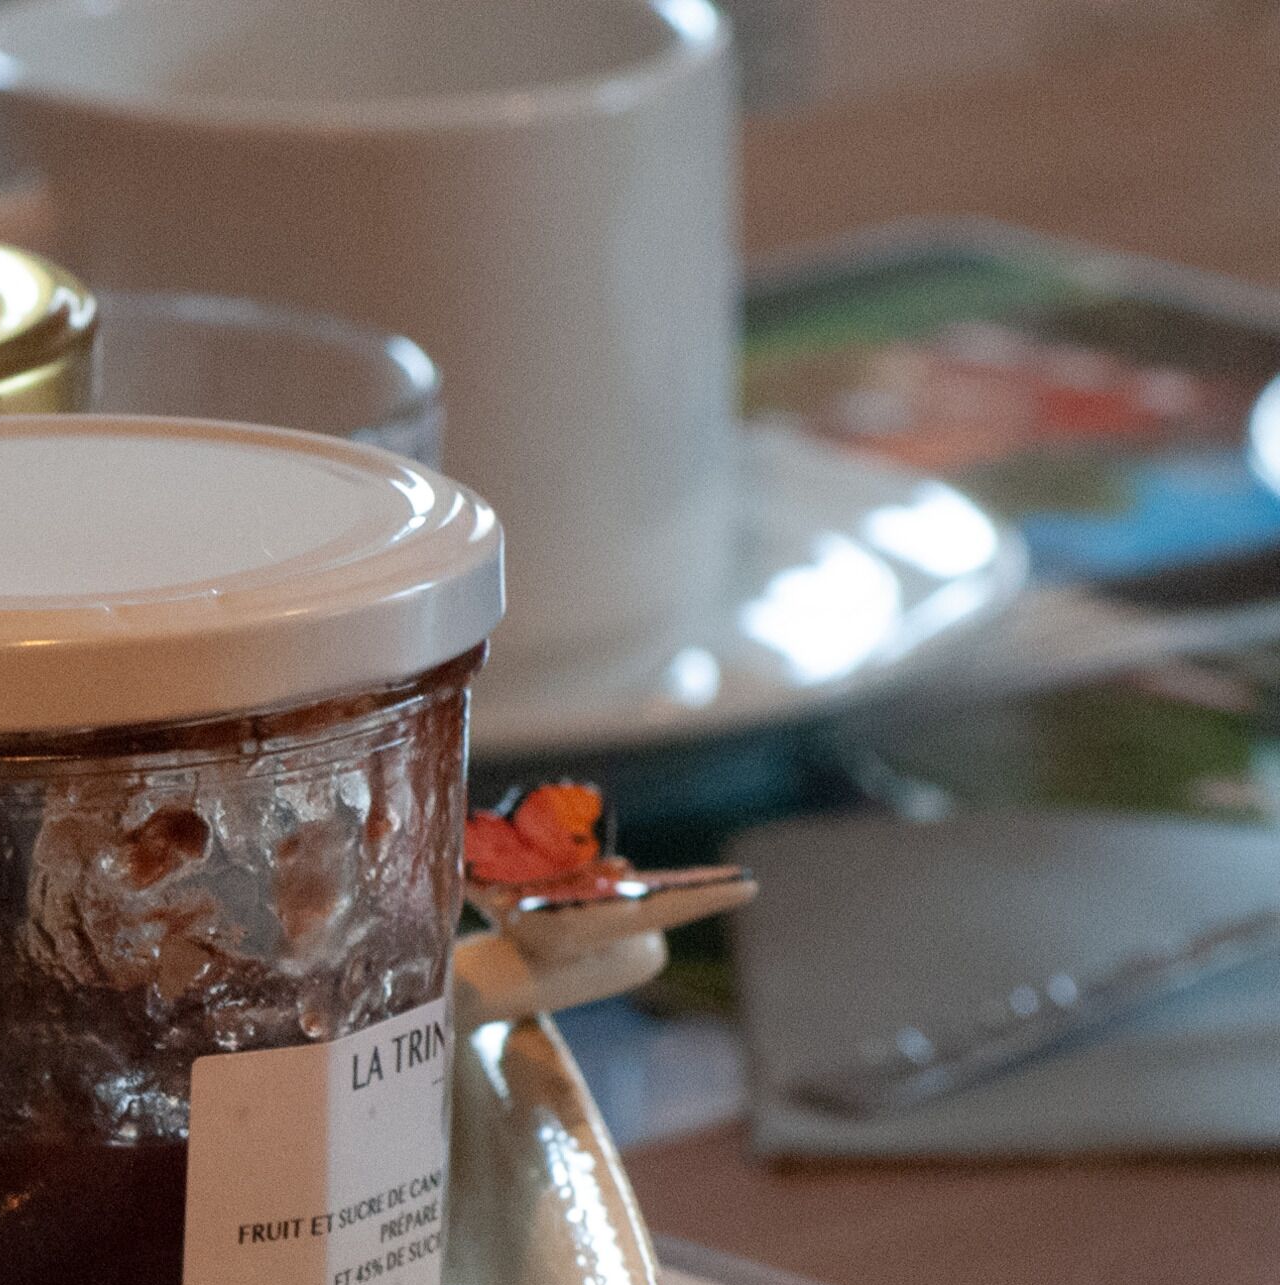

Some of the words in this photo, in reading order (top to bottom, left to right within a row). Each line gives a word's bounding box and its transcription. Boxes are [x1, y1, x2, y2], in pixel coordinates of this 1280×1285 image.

[352, 1046, 384, 1091] LA
[238, 1218, 304, 1245] FRUIT
[311, 1212, 334, 1237] ET
[338, 1193, 385, 1229] SUCRE
[387, 1183, 405, 1209] DE
[356, 1256, 384, 1284] 45%
[386, 1248, 406, 1272] DE
